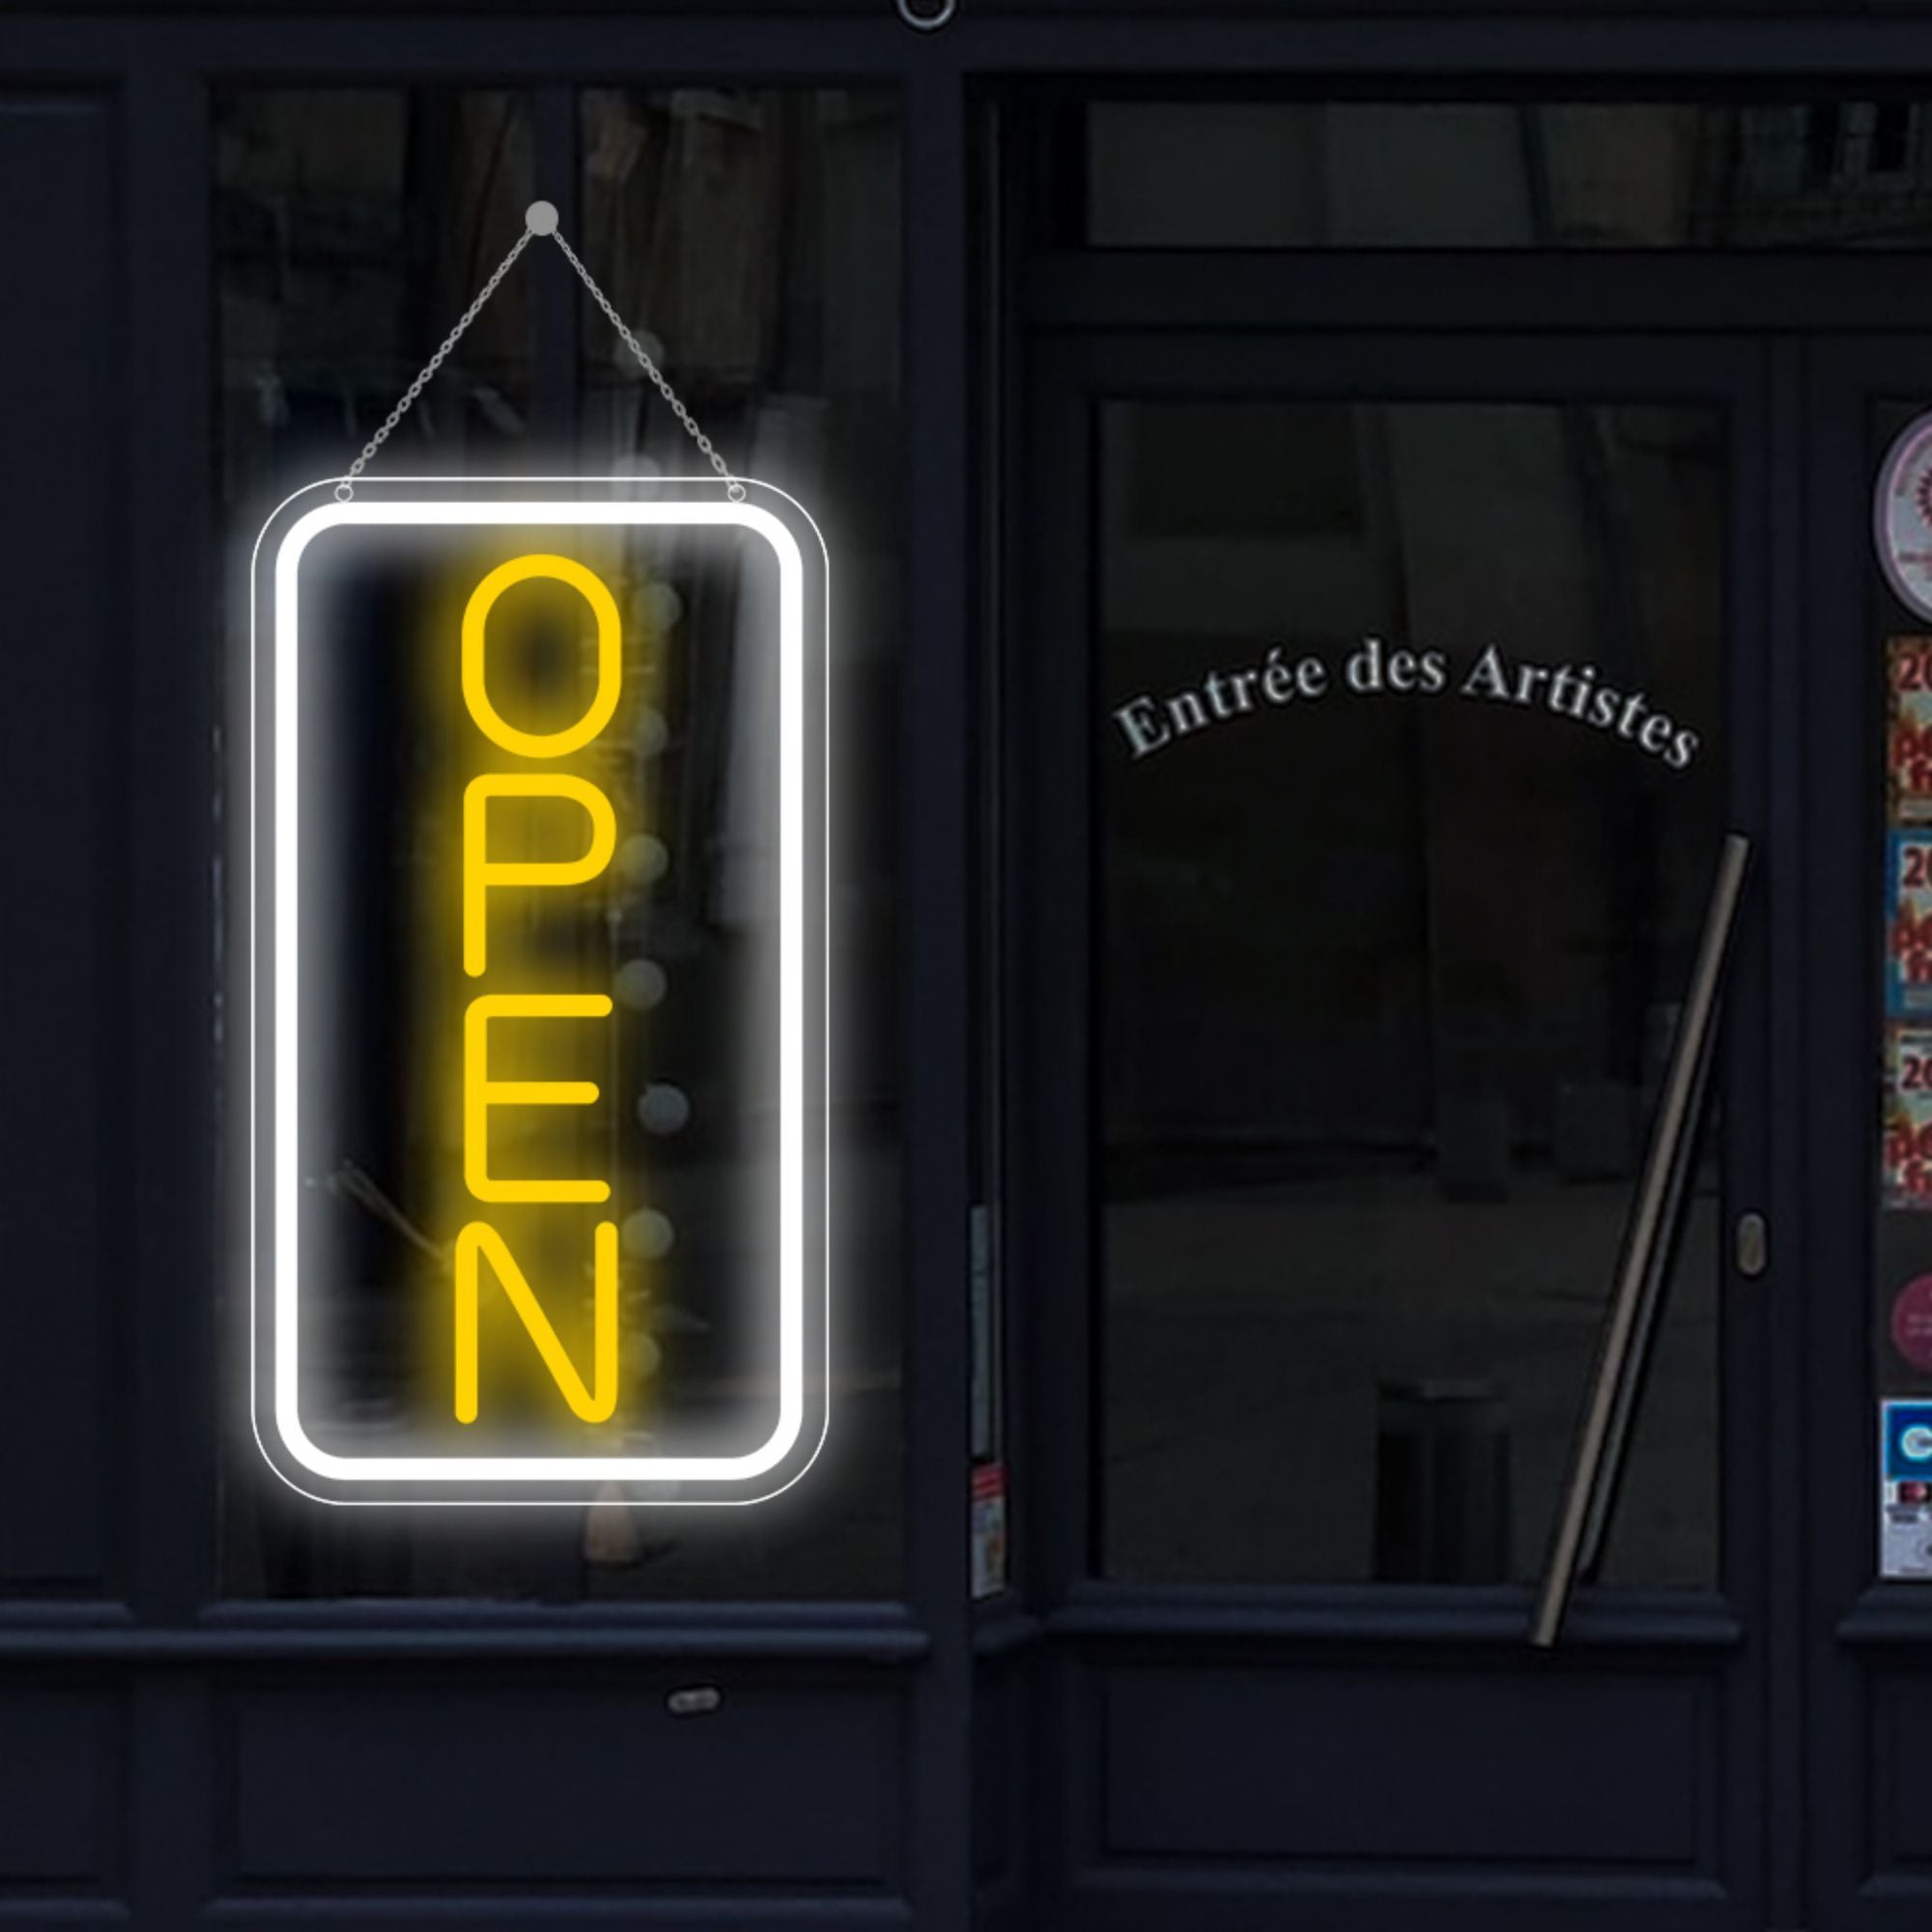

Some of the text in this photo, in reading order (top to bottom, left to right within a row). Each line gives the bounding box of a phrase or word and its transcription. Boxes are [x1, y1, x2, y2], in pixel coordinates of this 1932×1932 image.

[1114, 639, 1698, 768] Entrée des Artistes
[455, 554, 621, 1423] OPEN
